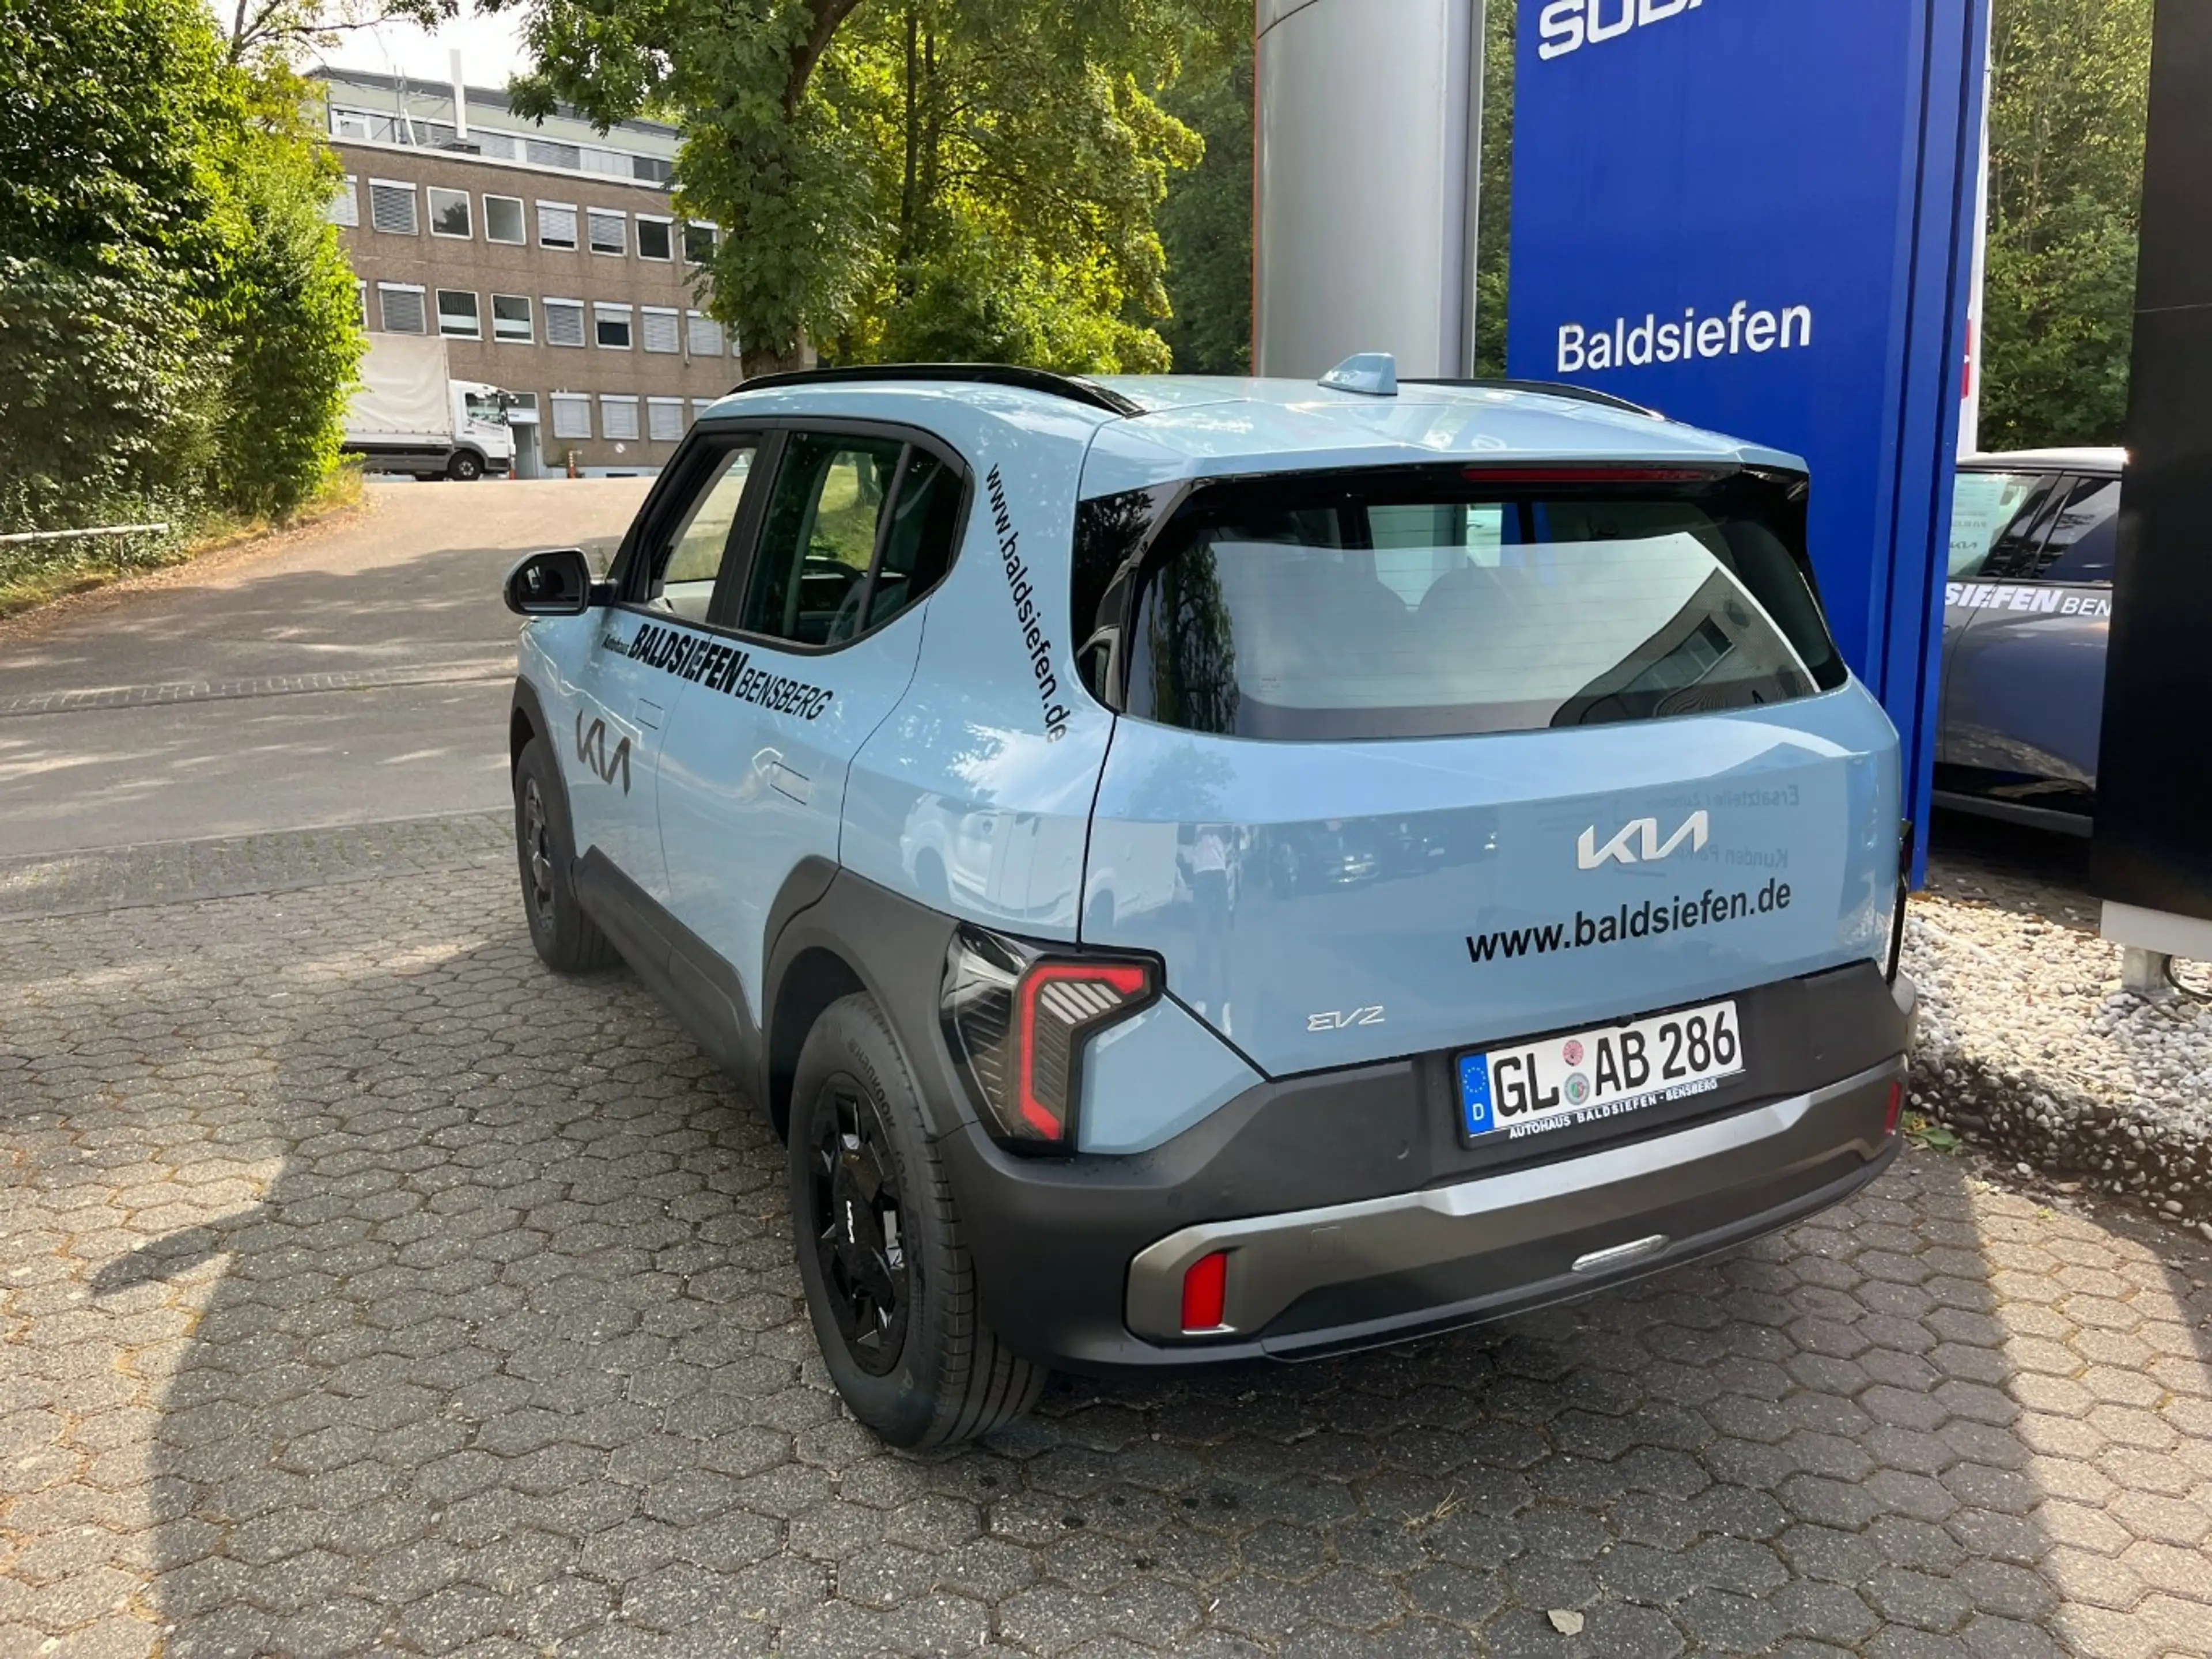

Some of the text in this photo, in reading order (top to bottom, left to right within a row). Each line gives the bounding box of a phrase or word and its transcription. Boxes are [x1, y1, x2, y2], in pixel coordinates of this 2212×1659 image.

[1557, 300, 1812, 373] Baldsiefen
[986, 462, 1071, 744] www.baldsiefen.de
[627, 623, 751, 694] BALDSIEFEN
[734, 667, 834, 721] BENSBERG
[1578, 809, 1708, 870] KIA
[1466, 877, 1791, 963] www.baldsiefen.de
[1307, 1005, 1385, 1032] EV2
[1493, 1010, 1736, 1118] GL AB 286
[1472, 1103, 1485, 1121] D
[1508, 1114, 1572, 1139] AUTOHAUS
[1576, 1094, 1658, 1123] BALDSIEFEN
[1665, 1076, 1718, 1101] BENSBERG
